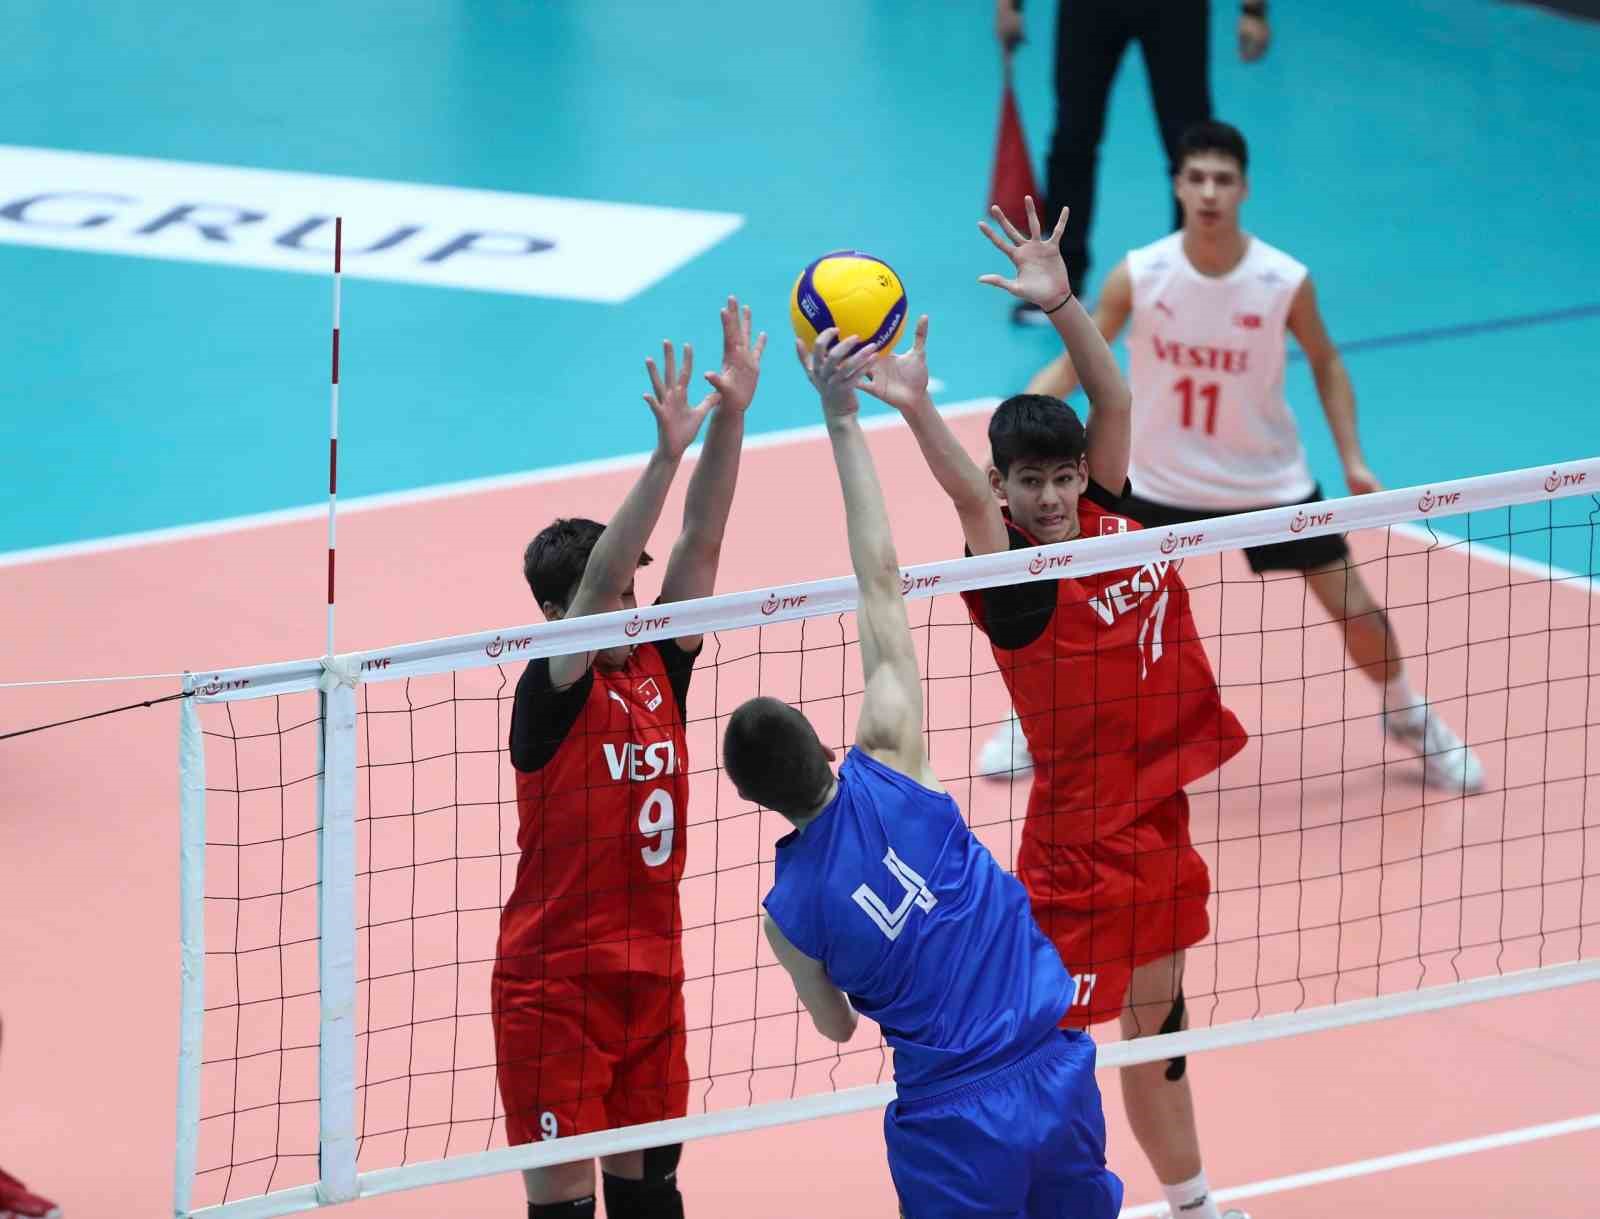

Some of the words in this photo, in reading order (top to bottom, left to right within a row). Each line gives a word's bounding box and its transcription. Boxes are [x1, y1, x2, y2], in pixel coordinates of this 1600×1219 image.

[0, 191, 557, 263] GRUP
[1174, 375, 1221, 437] 11
[1563, 472, 1587, 487] TVF
[1437, 492, 1462, 507] TVF
[1309, 512, 1334, 528] TVF
[1179, 533, 1205, 548] TVF
[1048, 554, 1073, 569] TVF
[916, 575, 942, 588] TVF
[782, 595, 808, 610] TVF
[645, 616, 671, 631] TVF
[506, 636, 533, 652] TVF
[638, 788, 675, 868] 9
[851, 846, 938, 941] 4
[1072, 974, 1097, 1006] 17
[540, 1111, 558, 1141] 9
